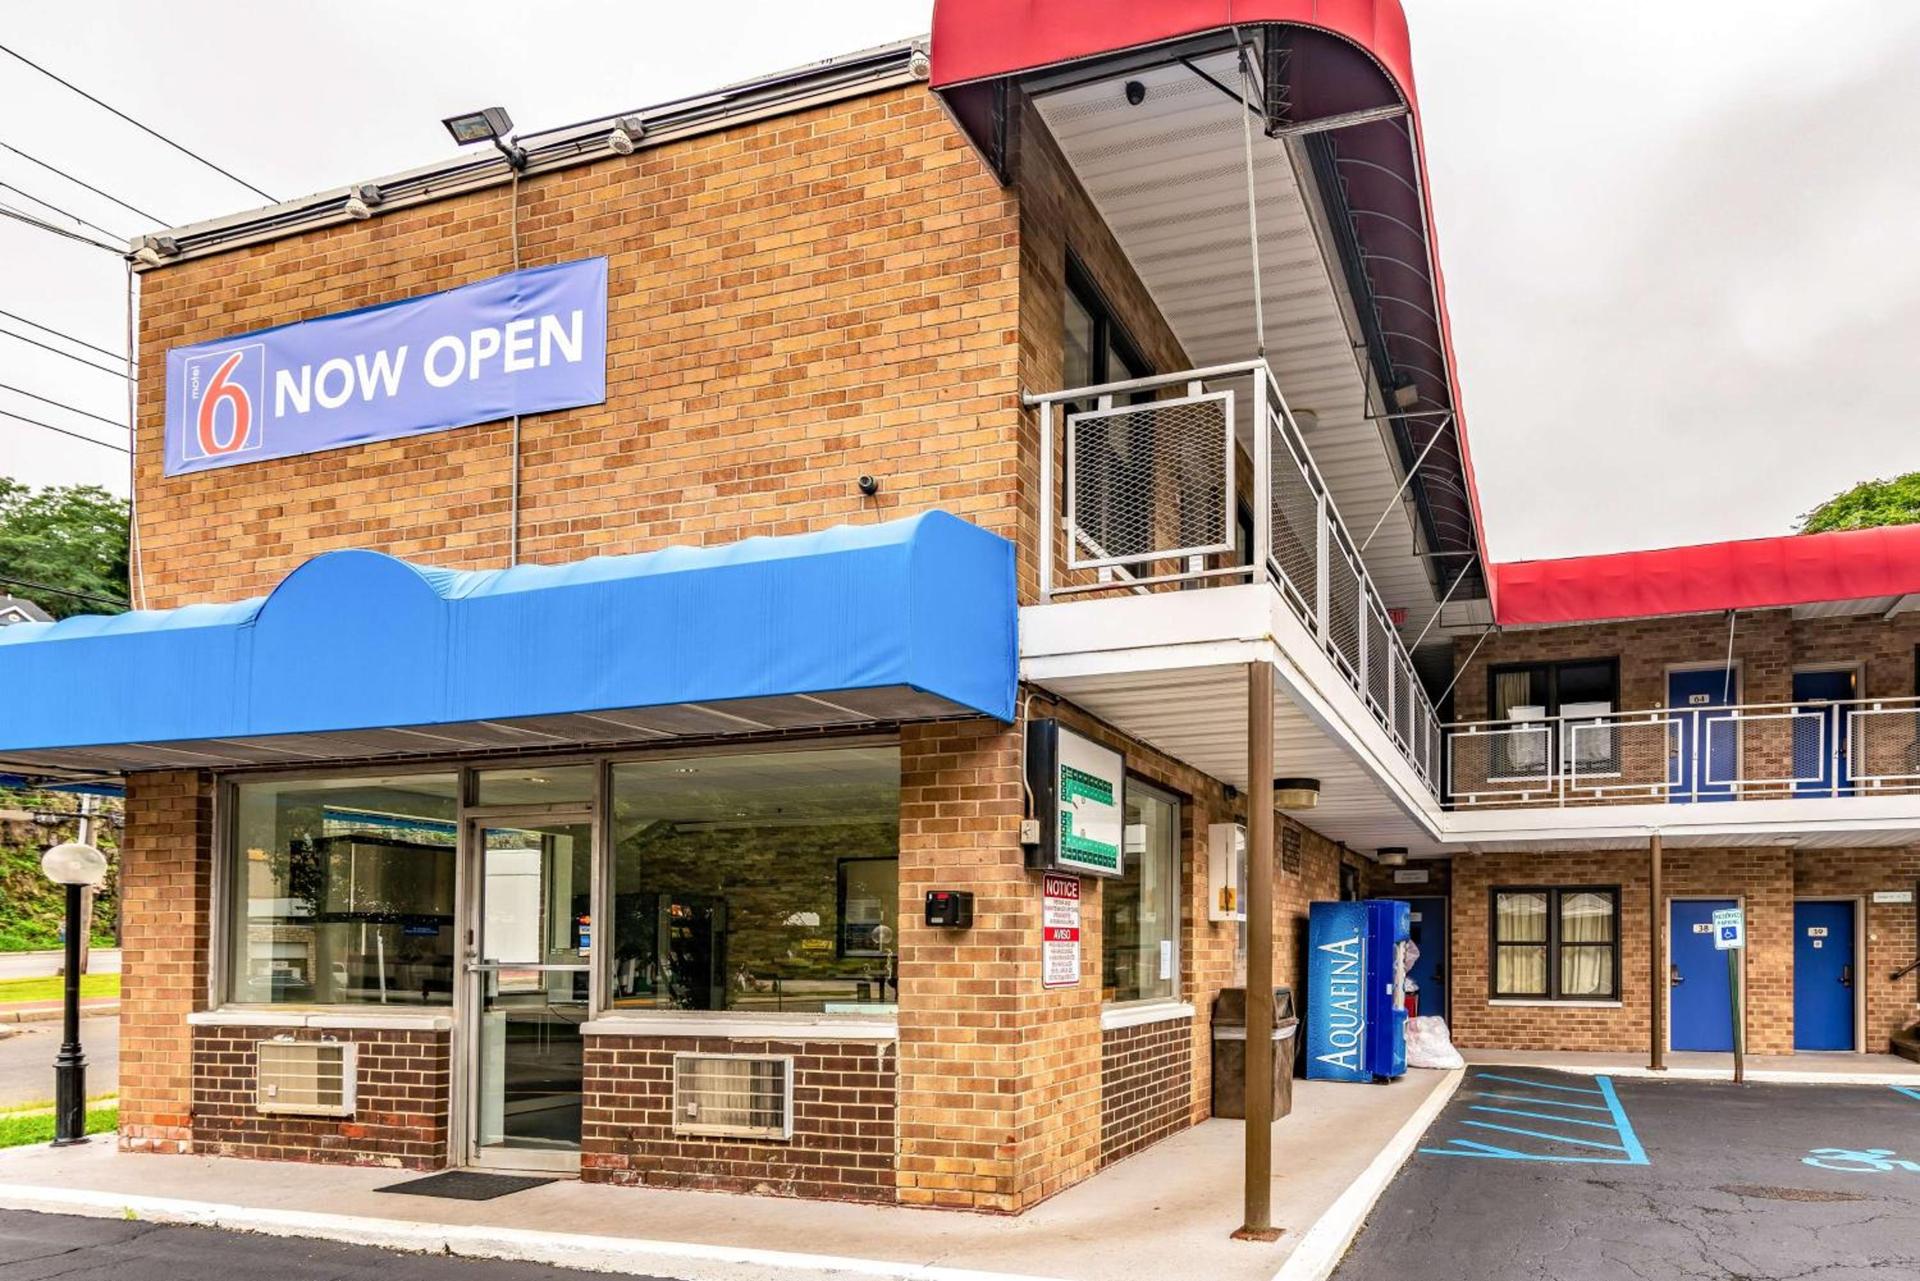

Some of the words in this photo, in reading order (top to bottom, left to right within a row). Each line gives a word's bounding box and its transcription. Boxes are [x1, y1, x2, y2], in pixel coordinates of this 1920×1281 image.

[191, 365, 200, 399] motel
[274, 345, 408, 418] NOW
[423, 309, 584, 388] OPEN
[197, 351, 252, 456] 6
[1046, 879, 1078, 898] NOTICE
[1053, 929, 1072, 940] AVISO
[1316, 937, 1365, 1072] AQUAFINA
